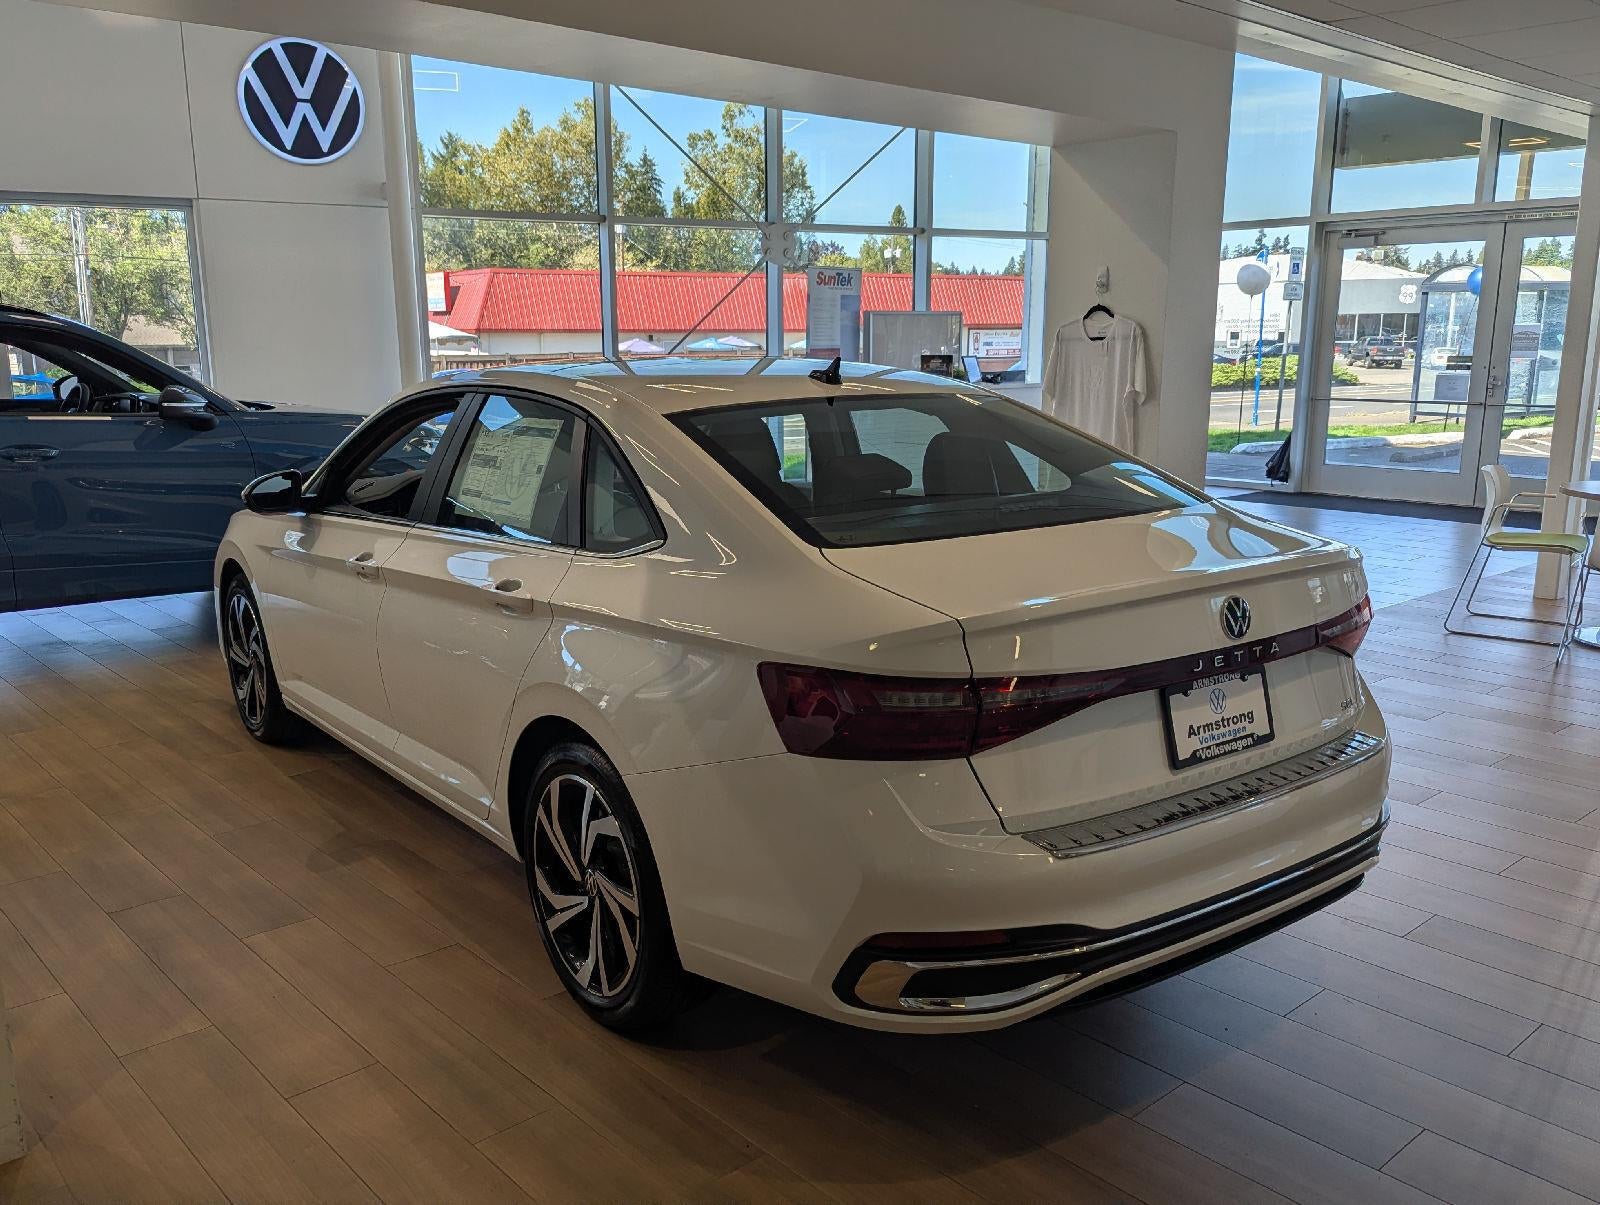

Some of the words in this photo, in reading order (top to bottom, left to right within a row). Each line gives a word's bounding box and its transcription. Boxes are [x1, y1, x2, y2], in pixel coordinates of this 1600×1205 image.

[237, 36, 366, 165] VW
[816, 271, 854, 287] SunTek
[1193, 642, 1281, 672] JETTA
[1192, 672, 1242, 691] ARMSTRONG
[1187, 709, 1255, 739] Armstrong
[1198, 725, 1248, 746] Volkswagen
[1198, 736, 1254, 760] Volkswagen
